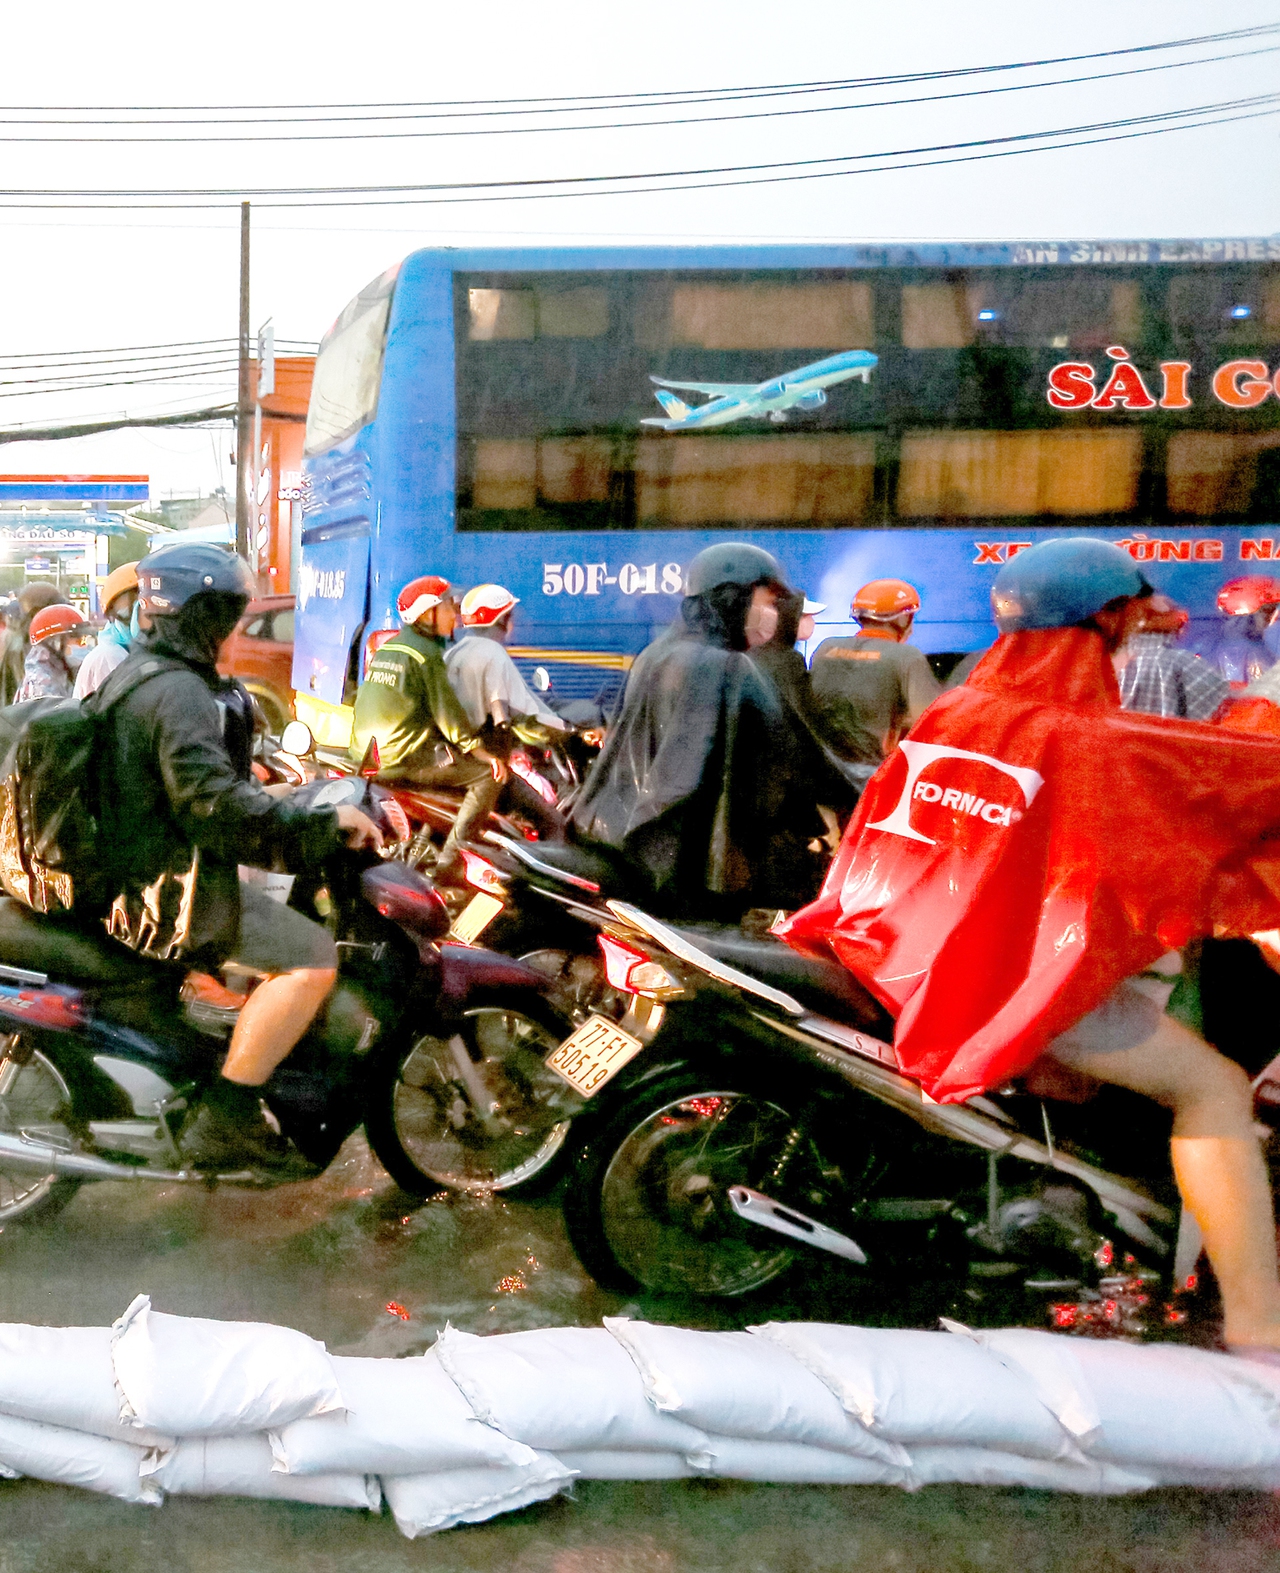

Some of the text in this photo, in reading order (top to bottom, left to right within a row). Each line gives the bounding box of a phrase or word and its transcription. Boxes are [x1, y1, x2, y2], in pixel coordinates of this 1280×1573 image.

[1047, 346, 1280, 409] SÀI G
[541, 562, 683, 595] 50F-018
[553, 1042, 609, 1091] 505.19
